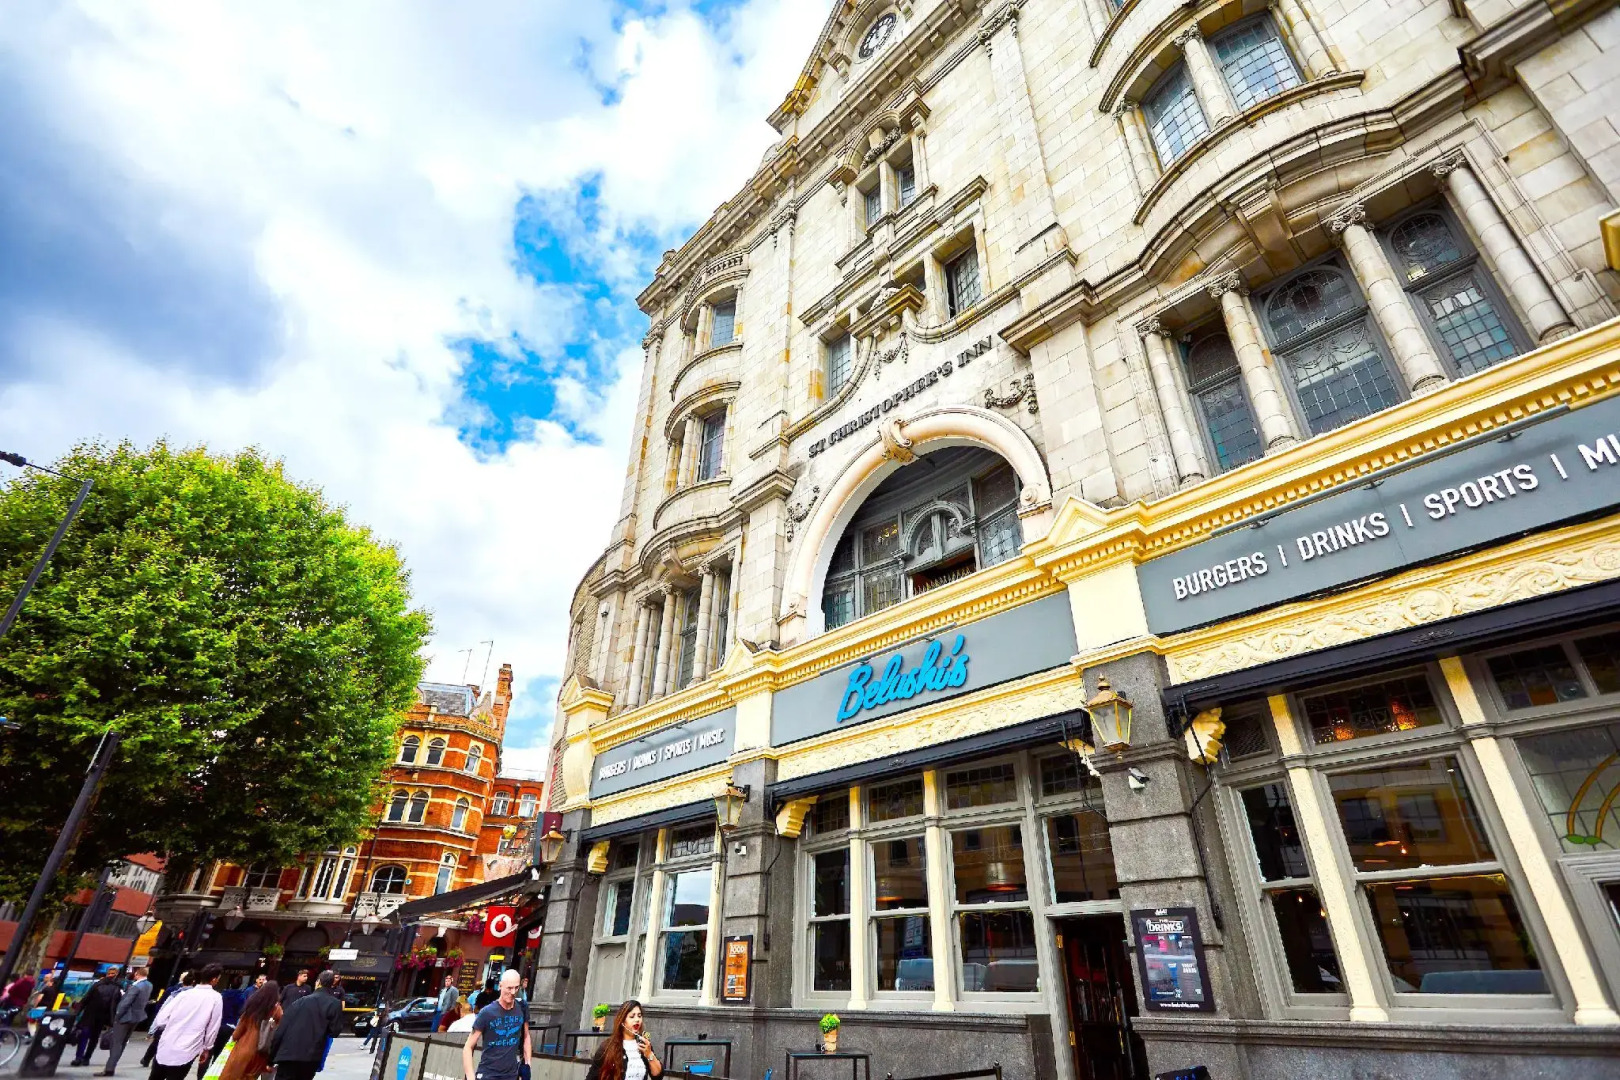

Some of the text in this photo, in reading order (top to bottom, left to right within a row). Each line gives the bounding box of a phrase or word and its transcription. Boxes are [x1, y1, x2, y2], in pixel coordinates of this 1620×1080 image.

[808, 335, 992, 458] ST CHRISTOPHER'S INN
[1172, 551, 1268, 600] BURGERS
[1296, 512, 1390, 561] DRINKS
[1423, 463, 1539, 520] SPORTS
[836, 634, 970, 723] Belushi's
[664, 739, 691, 760] SPORTS
[699, 728, 724, 749] MUSIC
[1148, 922, 1182, 932] DRINKS
